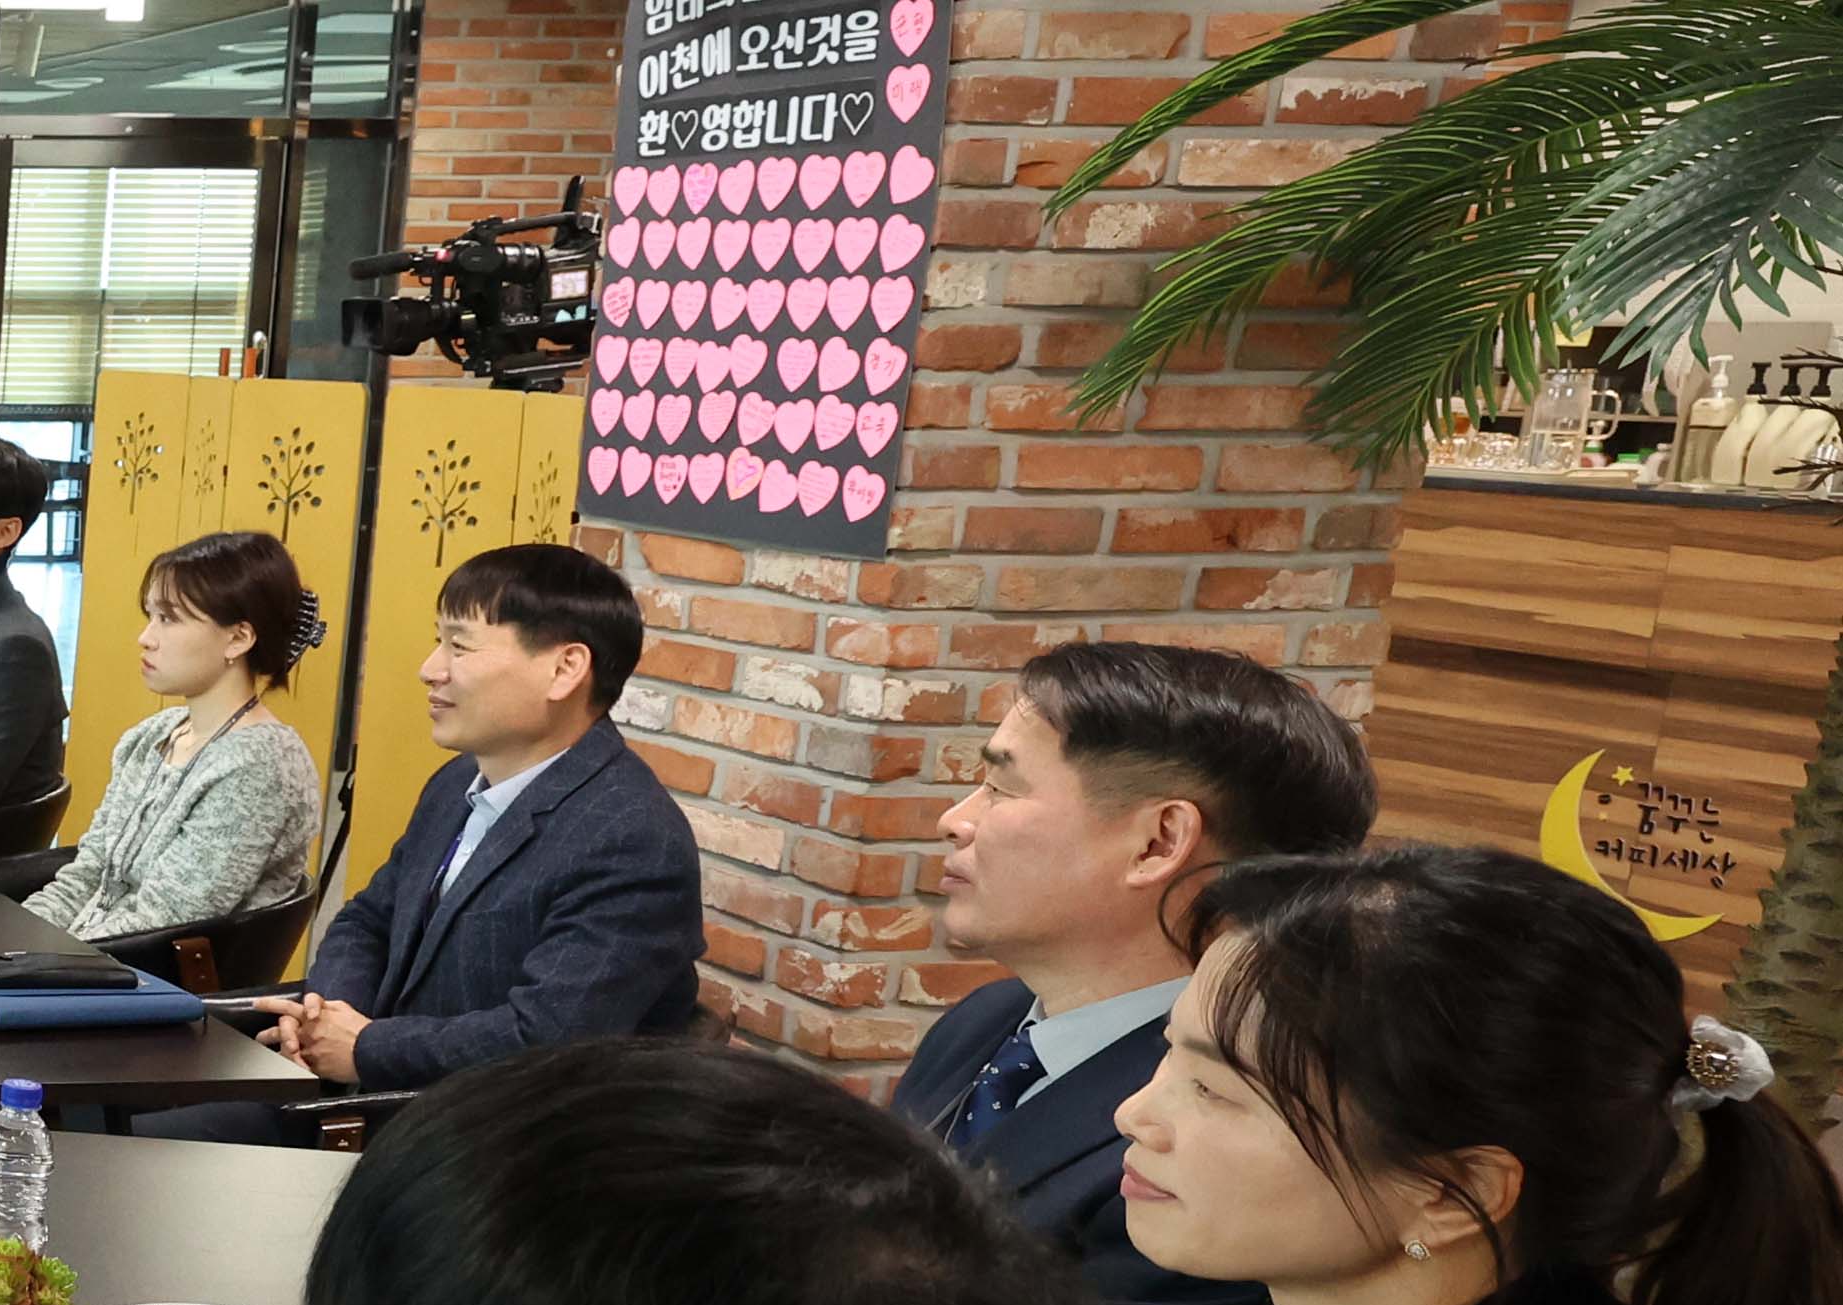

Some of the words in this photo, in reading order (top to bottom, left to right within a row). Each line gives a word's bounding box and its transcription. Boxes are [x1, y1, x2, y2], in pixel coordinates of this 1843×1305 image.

[638, 26, 731, 99] 이천에
[736, 10, 880, 71] 오신것을
[1638, 782, 1721, 844] 꿈꾸는
[1595, 838, 1737, 889] 커피세상
